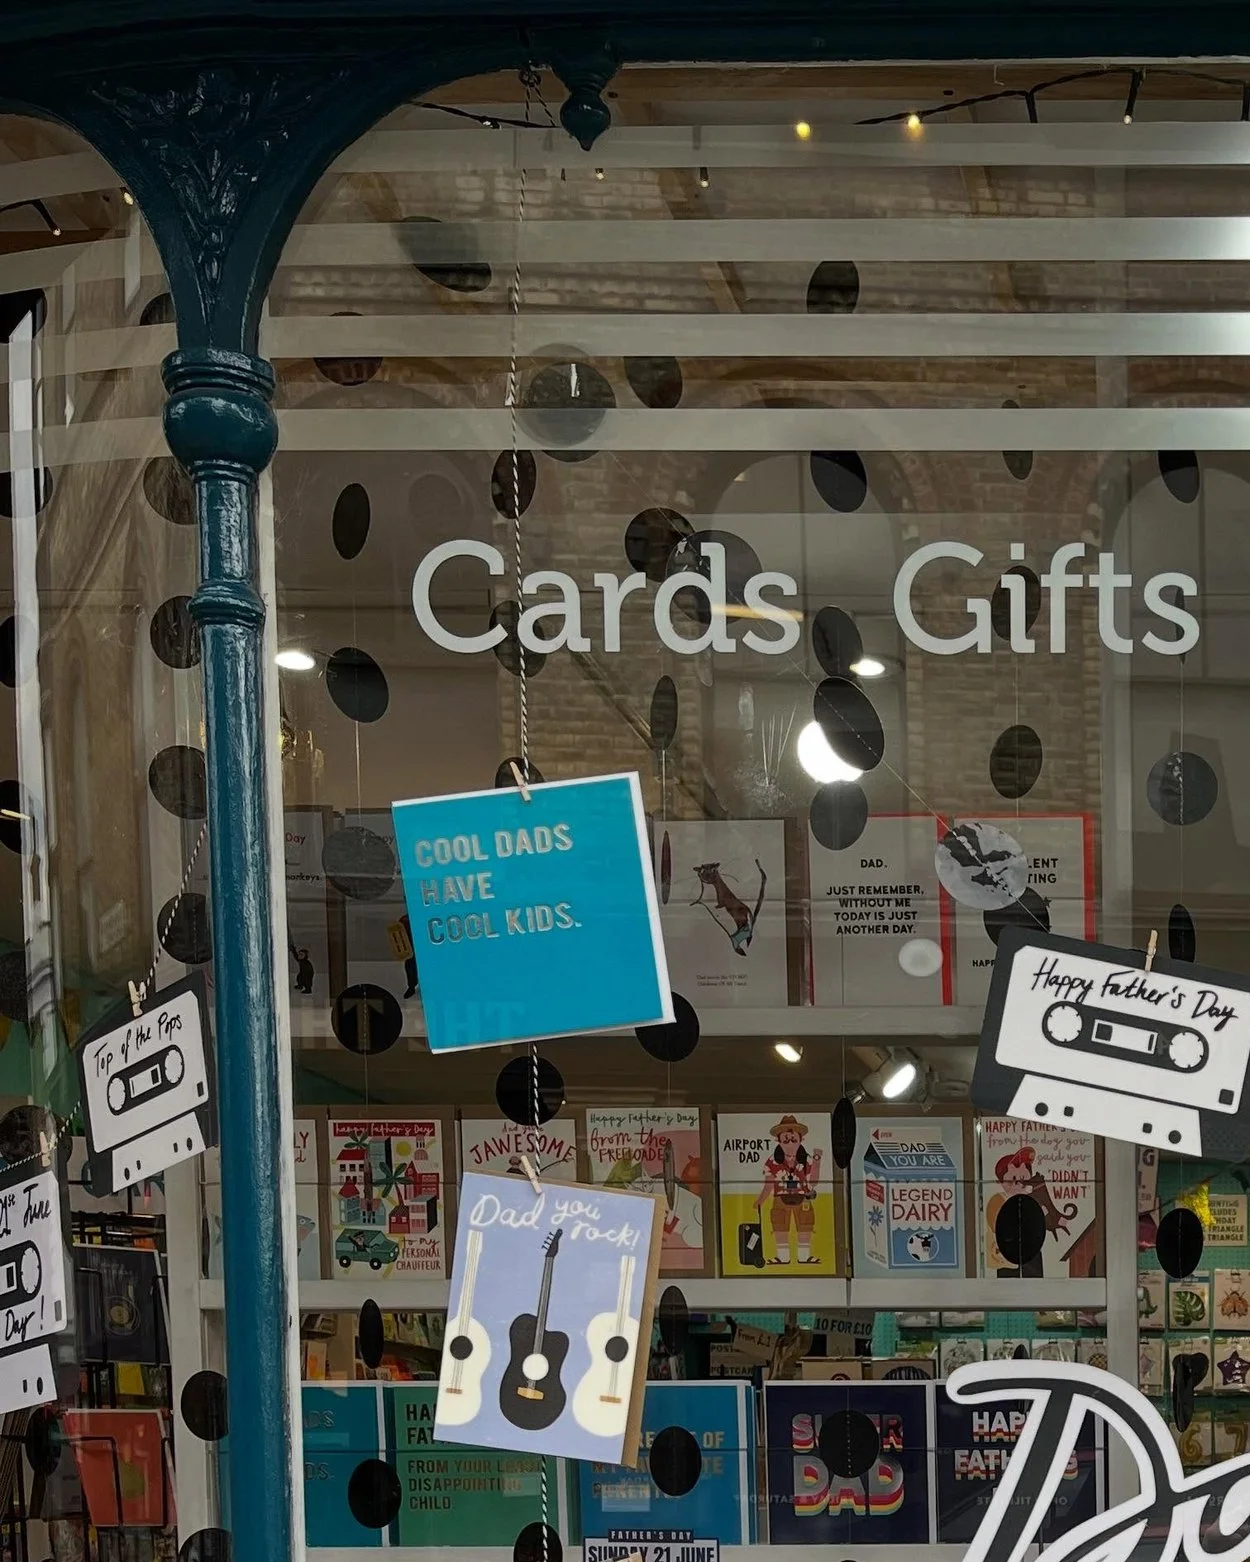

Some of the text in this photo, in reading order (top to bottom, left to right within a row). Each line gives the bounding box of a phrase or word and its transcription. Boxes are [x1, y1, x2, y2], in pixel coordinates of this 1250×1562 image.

[411, 540, 800, 655] Cards
[893, 541, 1201, 655] Gifts
[415, 823, 573, 867] COOL DADS
[860, 858, 888, 869] DAD.
[420, 872, 495, 906] HAVE
[826, 885, 925, 897] JUST REMEMBER,
[838, 897, 911, 908] WITHOUT ME
[833, 910, 918, 922] TODAY IS JUST
[427, 902, 583, 945] COOL KIDS.
[836, 924, 917, 936] ANOTHER DAY.
[1031, 957, 1238, 1031] Happy Father's Day
[94, 1010, 183, 1078] Top of the Pops
[590, 1111, 698, 1127] Happy Father's Day
[413, 1124, 433, 1135] Day
[985, 1121, 1018, 1132] HAPPY
[590, 1126, 666, 1151] from the
[723, 1138, 772, 1152] AIRPORT
[470, 1132, 577, 1165] JAWESOME
[599, 1148, 664, 1162] FREELOADE
[900, 1143, 926, 1153] DAD
[738, 1152, 761, 1164] DAD
[889, 1155, 945, 1166] YOU ARE
[891, 1188, 953, 1202] LEGEND
[23, 1183, 52, 1228] June
[470, 1193, 603, 1229] Dad you
[891, 1203, 953, 1222] DAIRY
[570, 1220, 641, 1250] rock!
[401, 1247, 440, 1258] PERSONAL
[396, 1260, 441, 1271] CHAUFFEUR
[815, 1318, 872, 1335] 10 FOR £10
[712, 1366, 753, 1376] POSTCAR
[703, 1431, 726, 1449] OF
[408, 1459, 449, 1473] FROM
[454, 1458, 492, 1473] YOUR
[791, 1455, 905, 1517] DAD
[410, 1496, 451, 1510] CHILD
[611, 1531, 691, 1540] FATHER'S DAY
